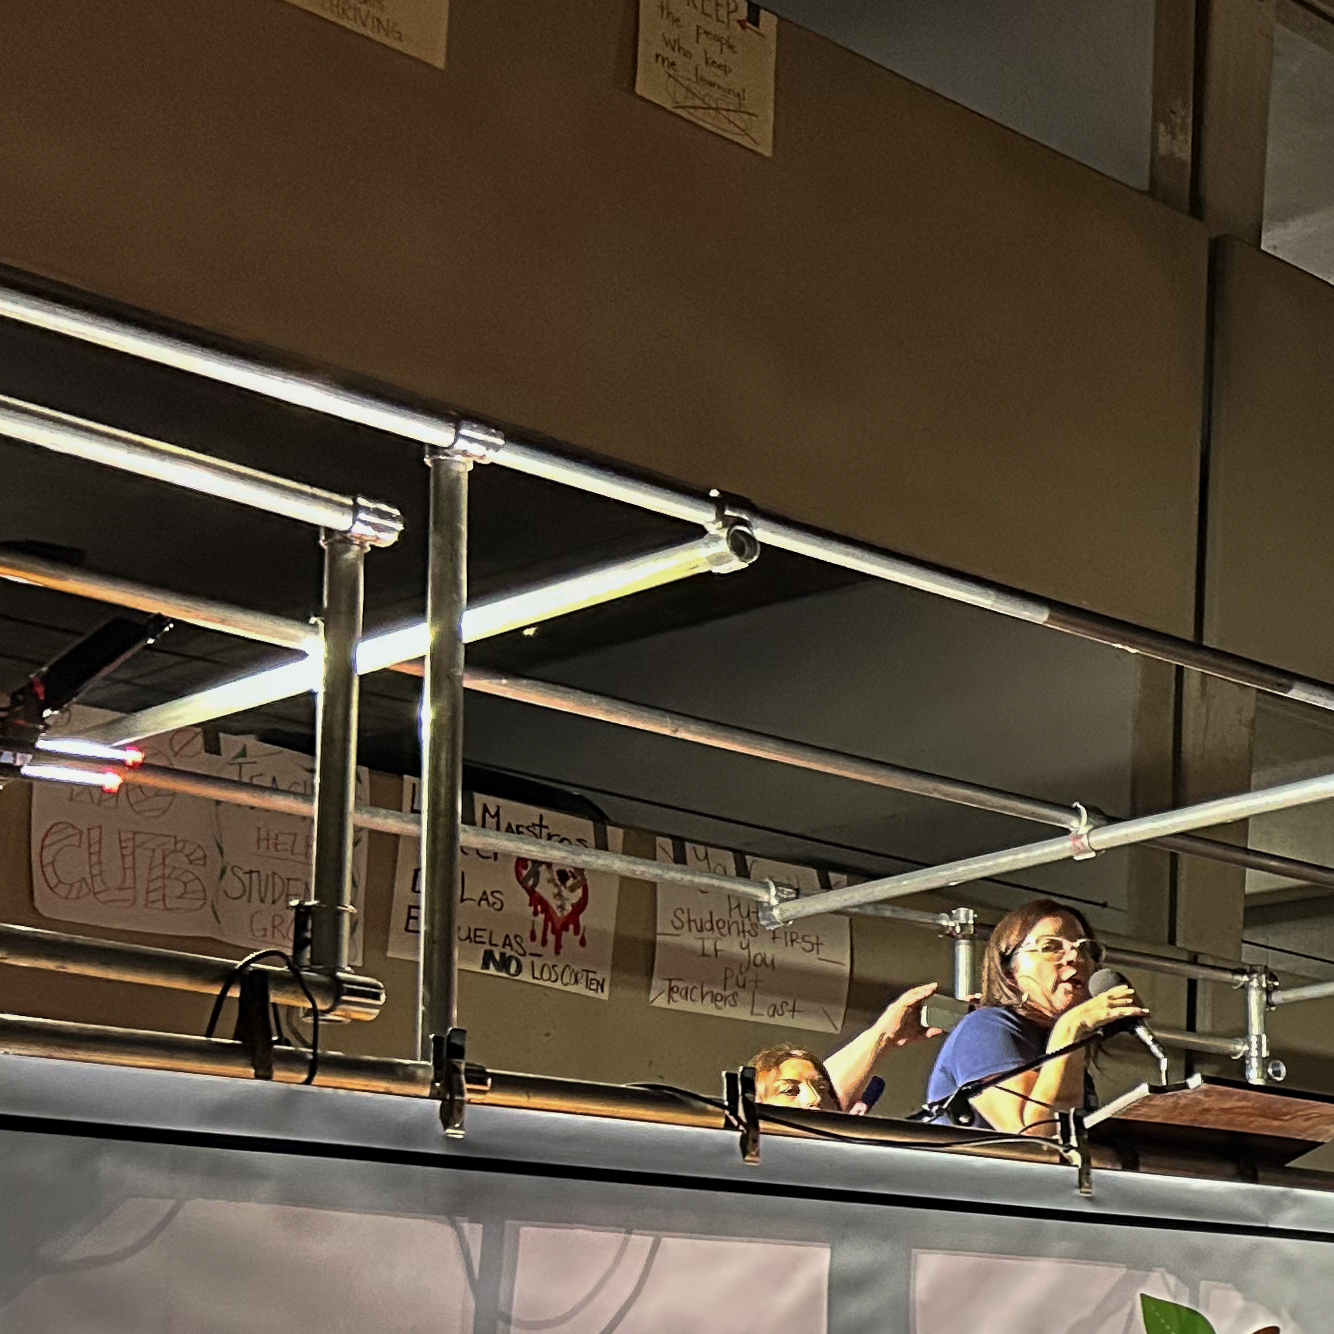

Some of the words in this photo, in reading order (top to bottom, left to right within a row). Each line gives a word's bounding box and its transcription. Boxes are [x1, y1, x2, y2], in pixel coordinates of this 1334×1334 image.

[658, 1, 683, 28] the
[695, 25, 737, 54] people
[655, 52, 679, 72] me
[40, 821, 207, 912] CUTS
[460, 871, 505, 912] LAS
[671, 908, 759, 938] Students
[481, 949, 523, 977] NO
[531, 960, 559, 984] LOS
[662, 978, 739, 1010] Teachers
[751, 991, 803, 1019] Last
